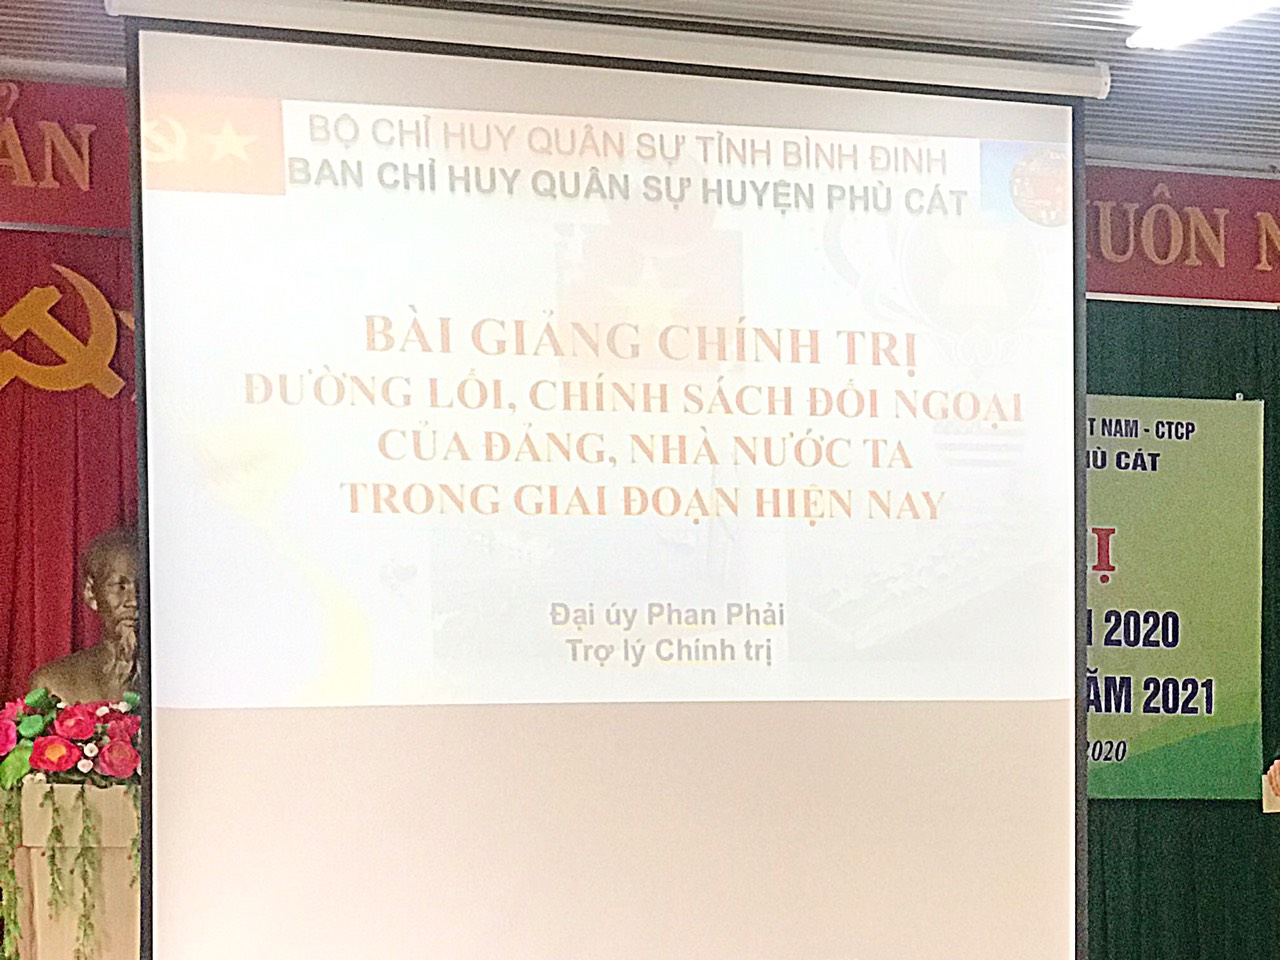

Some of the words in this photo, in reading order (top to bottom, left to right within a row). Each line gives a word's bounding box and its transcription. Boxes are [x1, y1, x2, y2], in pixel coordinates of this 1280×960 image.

[309, 113, 360, 149] BỘ
[372, 114, 432, 148] CHỈ
[443, 121, 517, 151] HUY
[527, 123, 624, 159] QUÂN
[636, 132, 685, 166] SỰ
[696, 131, 771, 168] TỈNH
[783, 135, 858, 171] BÌNH
[288, 156, 364, 188] BAN
[377, 158, 437, 191] CHỈ
[448, 165, 521, 195] HUY
[531, 166, 630, 201] QUÂN
[642, 175, 691, 210] SỰ
[702, 178, 815, 215] HUYỆN
[827, 180, 892, 212] PHÙ
[904, 184, 968, 216] CÁT
[1086, 183, 1230, 268] UÔN
[365, 304, 453, 353] BÀI
[471, 309, 642, 360] GIẢNG
[658, 316, 821, 364] CHÍNH
[836, 330, 918, 378] TRỊ
[244, 364, 412, 409] ĐƯỜNG
[529, 372, 669, 414] CHÍNH
[683, 376, 793, 416] SÁCH
[894, 389, 1024, 429] NGOẠI
[377, 420, 471, 462] CỦA
[482, 422, 617, 467] ĐẢNG,
[630, 426, 719, 465] NHÀ
[732, 428, 851, 468] NƯỚC
[863, 438, 913, 469] TA
[1101, 418, 1138, 438] NAM
[1155, 420, 1195, 440] CTCP
[1116, 448, 1160, 471] CÁT
[340, 481, 501, 516] TRONG
[514, 484, 610, 517] GIAI
[622, 485, 740, 526] ĐOẠN
[755, 484, 852, 527] HIỆN
[868, 490, 945, 520] NAY
[549, 602, 595, 631] Đại
[605, 602, 638, 631] úy
[648, 602, 716, 625] Phan
[727, 602, 785, 625] Phải
[1104, 610, 1179, 648] 2020
[565, 639, 614, 667] Trợ
[623, 638, 646, 667] lý
[655, 638, 736, 661] Chính
[744, 638, 772, 666] trị
[1142, 677, 1213, 714] 2021
[1087, 740, 1127, 762] 020
